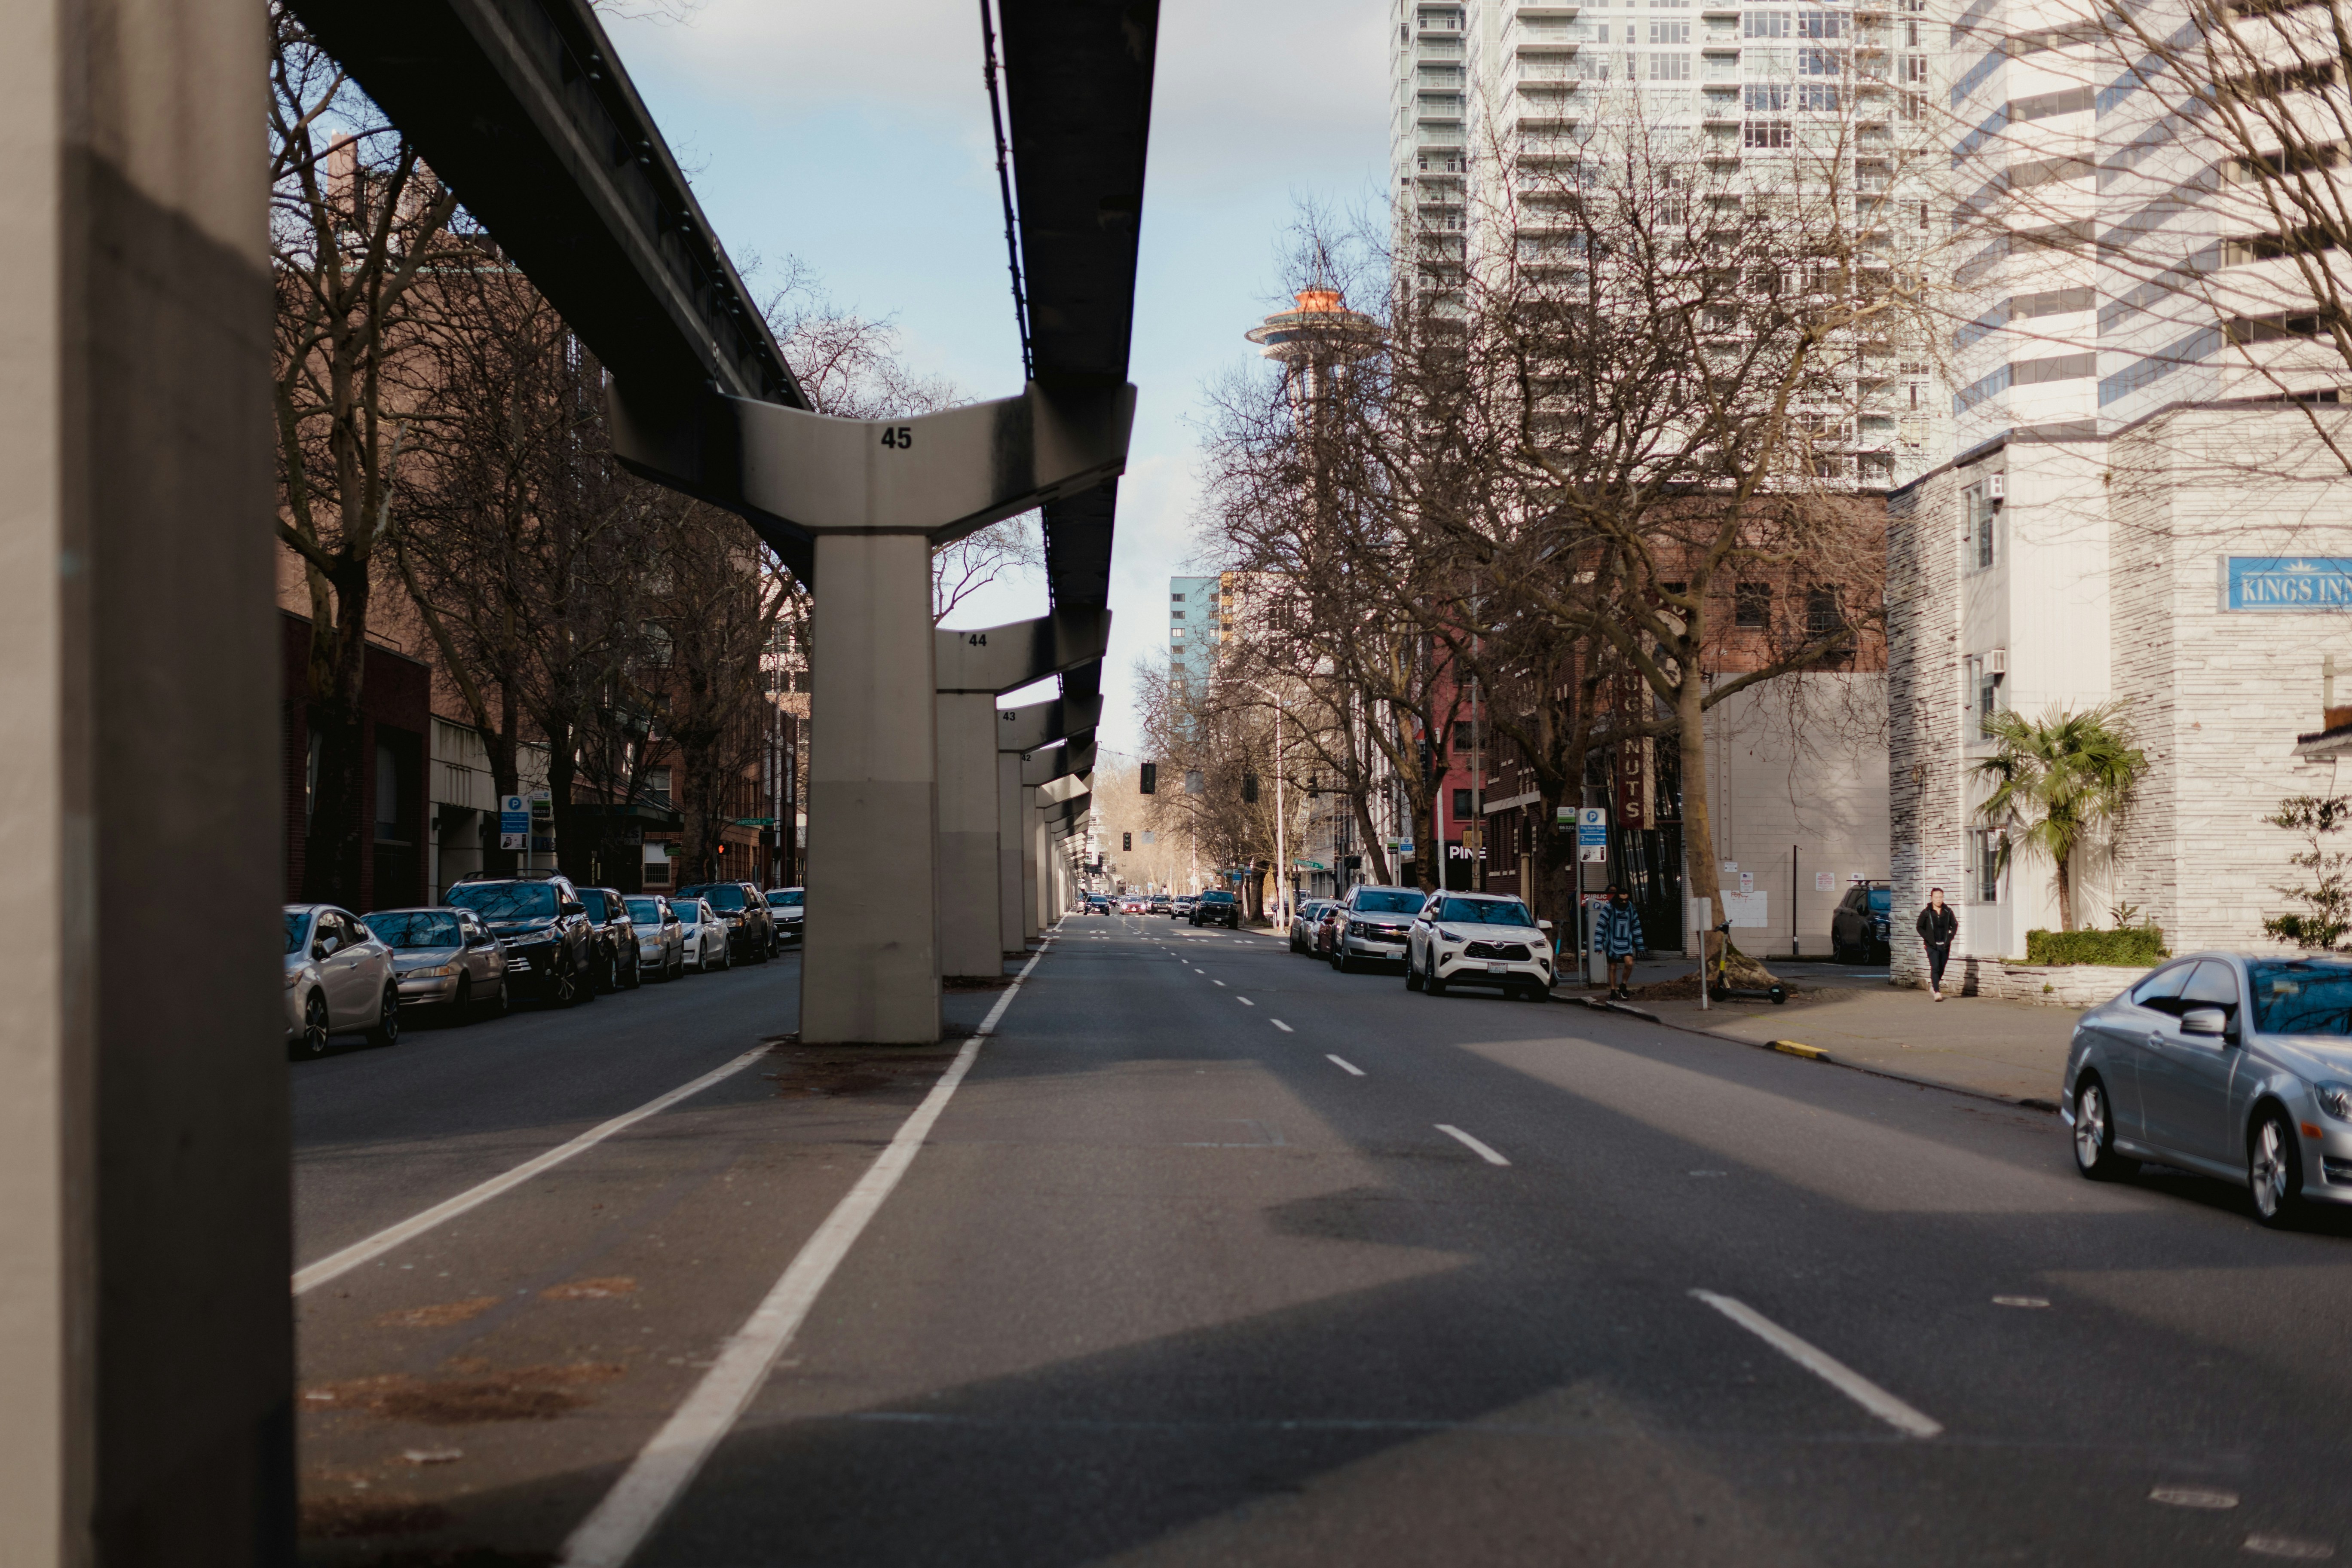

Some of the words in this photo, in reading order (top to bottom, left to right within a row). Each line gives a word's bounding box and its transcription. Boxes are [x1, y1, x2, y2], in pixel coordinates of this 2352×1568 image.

[881, 427, 911, 449] 45
[2242, 578, 2312, 601] KINGS
[969, 634, 987, 646] 44
[1003, 712, 1015, 721] 43
[1294, 858, 1314, 867] Blanchard
